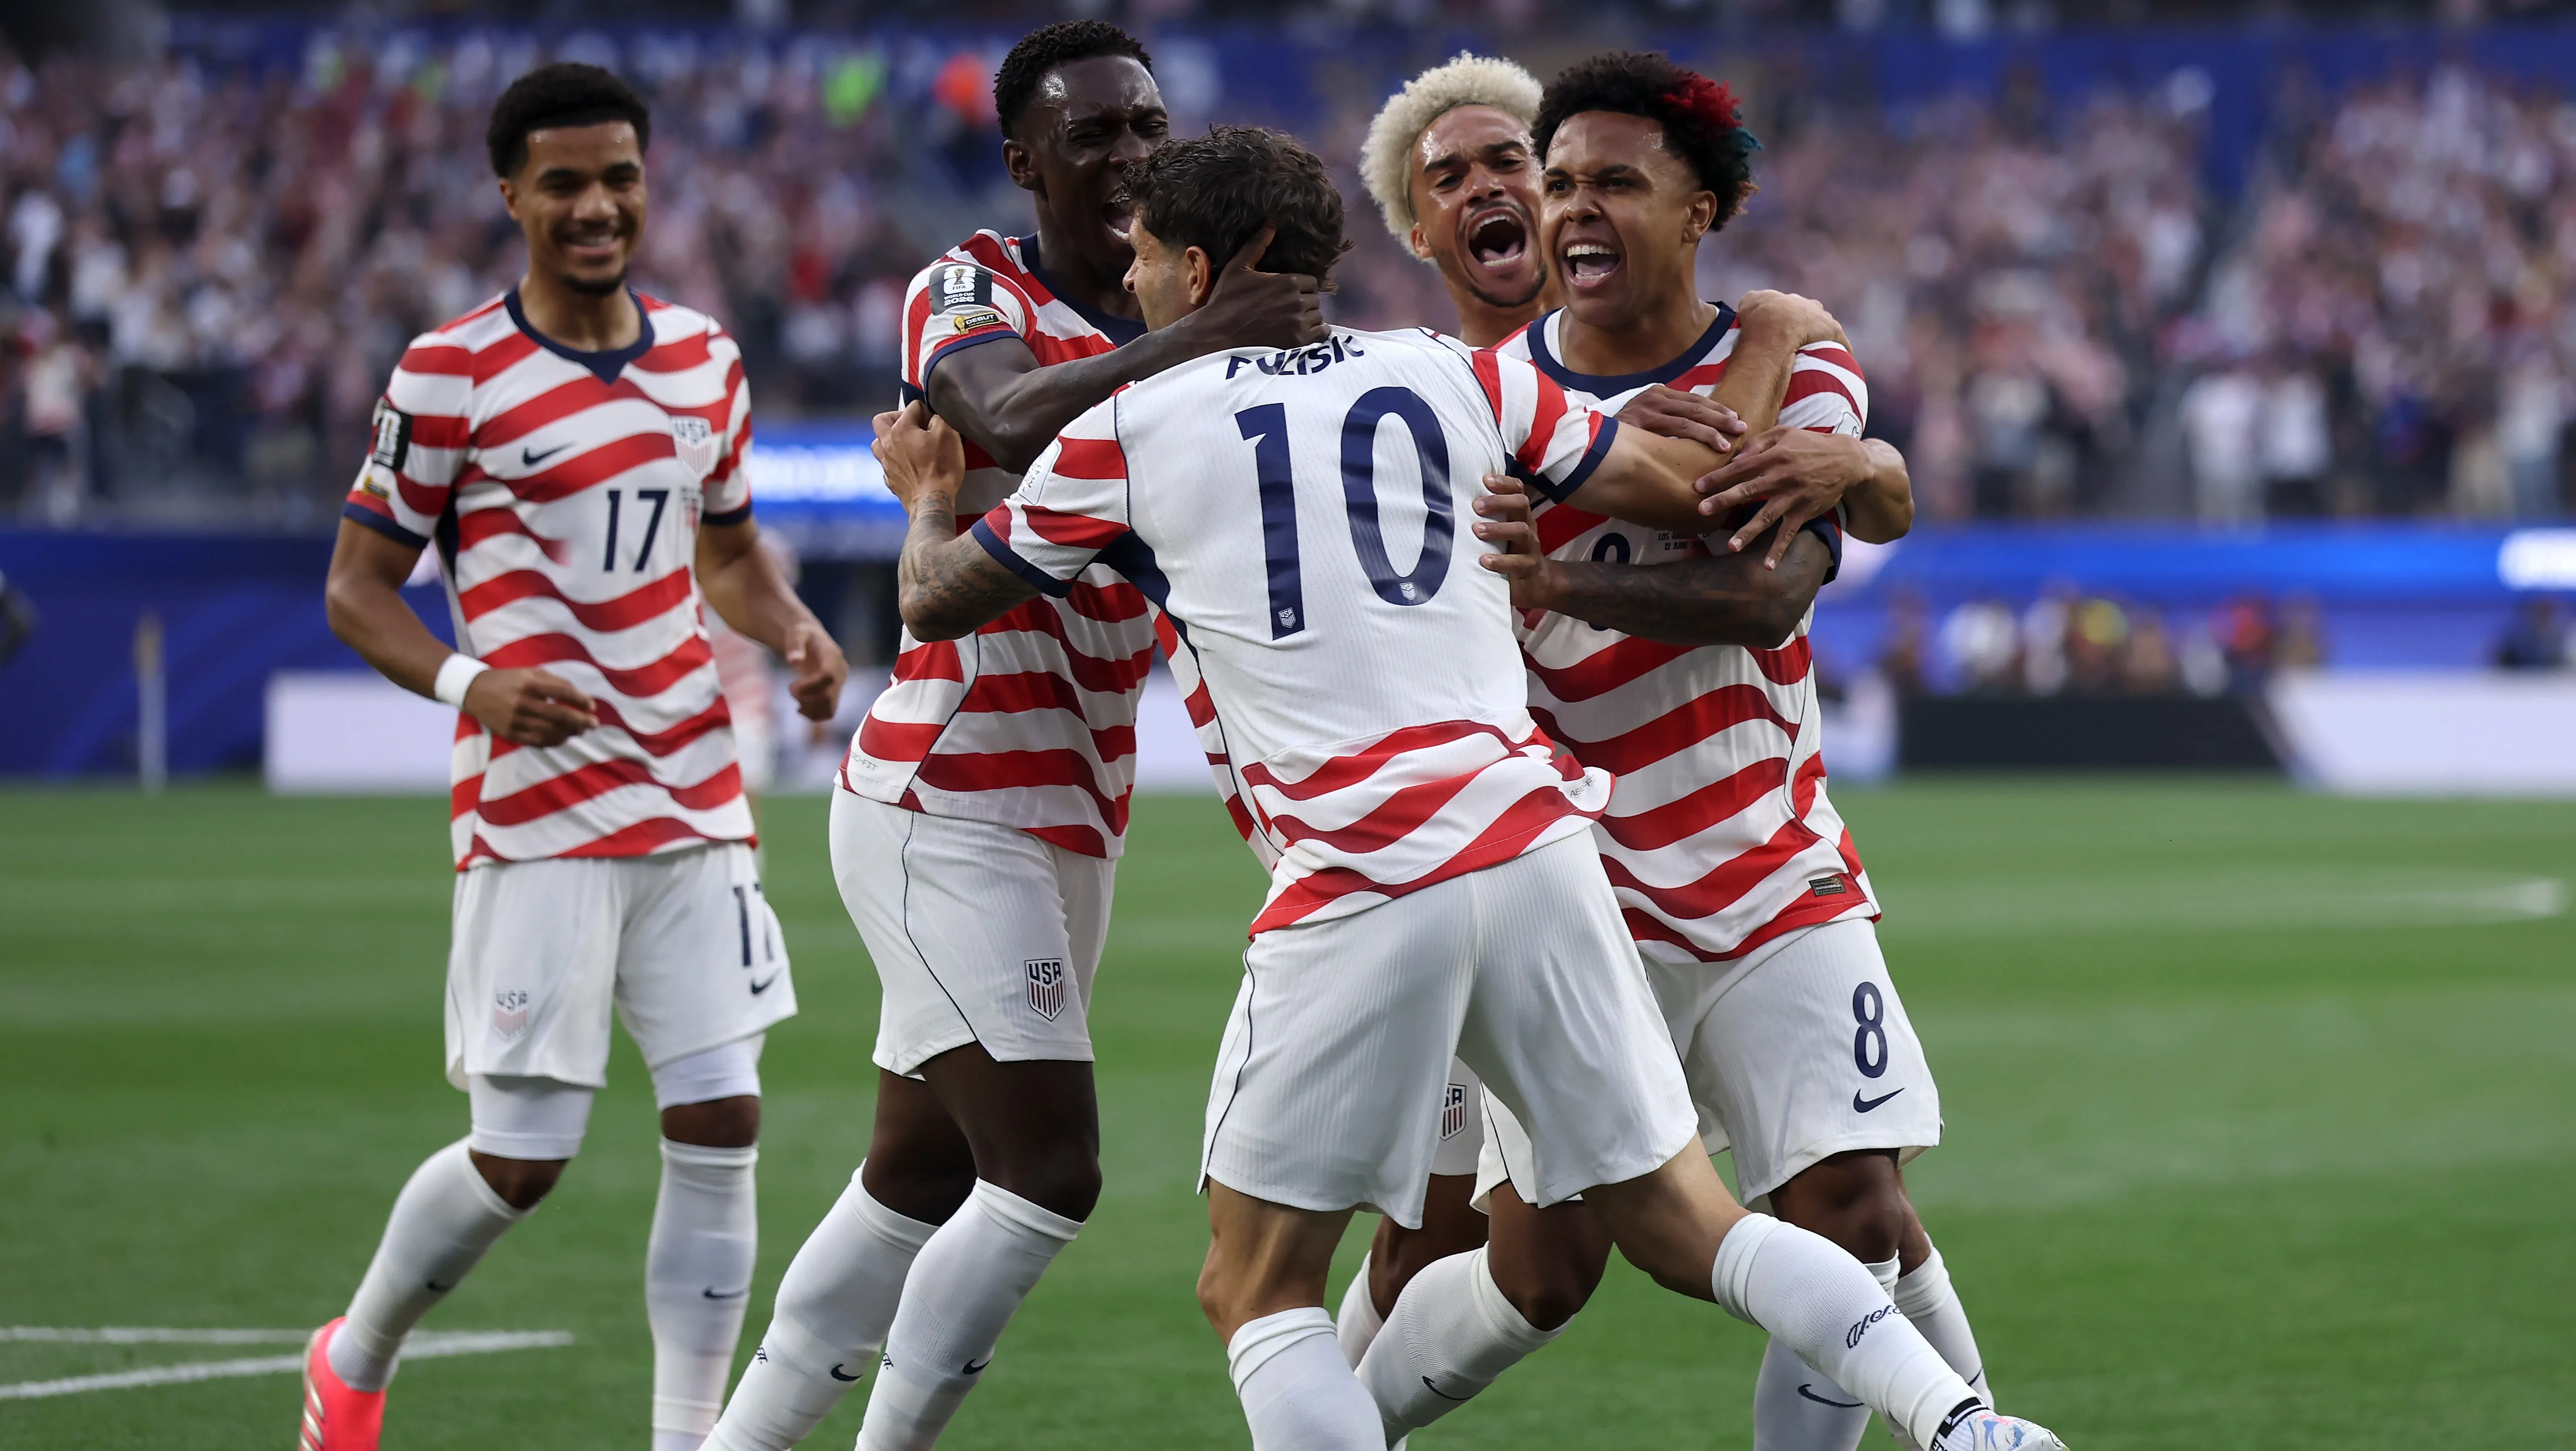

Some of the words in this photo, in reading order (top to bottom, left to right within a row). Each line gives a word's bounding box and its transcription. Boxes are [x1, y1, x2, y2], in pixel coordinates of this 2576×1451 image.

[944, 296, 975, 306] 2026
[965, 314, 994, 325] DEBUT
[1234, 386, 1455, 641] 10
[605, 490, 669, 572] 17
[1280, 609, 1293, 618] USA
[1028, 962, 1062, 985] USA
[496, 992, 528, 1012] USA
[1852, 981, 1888, 1078] 8
